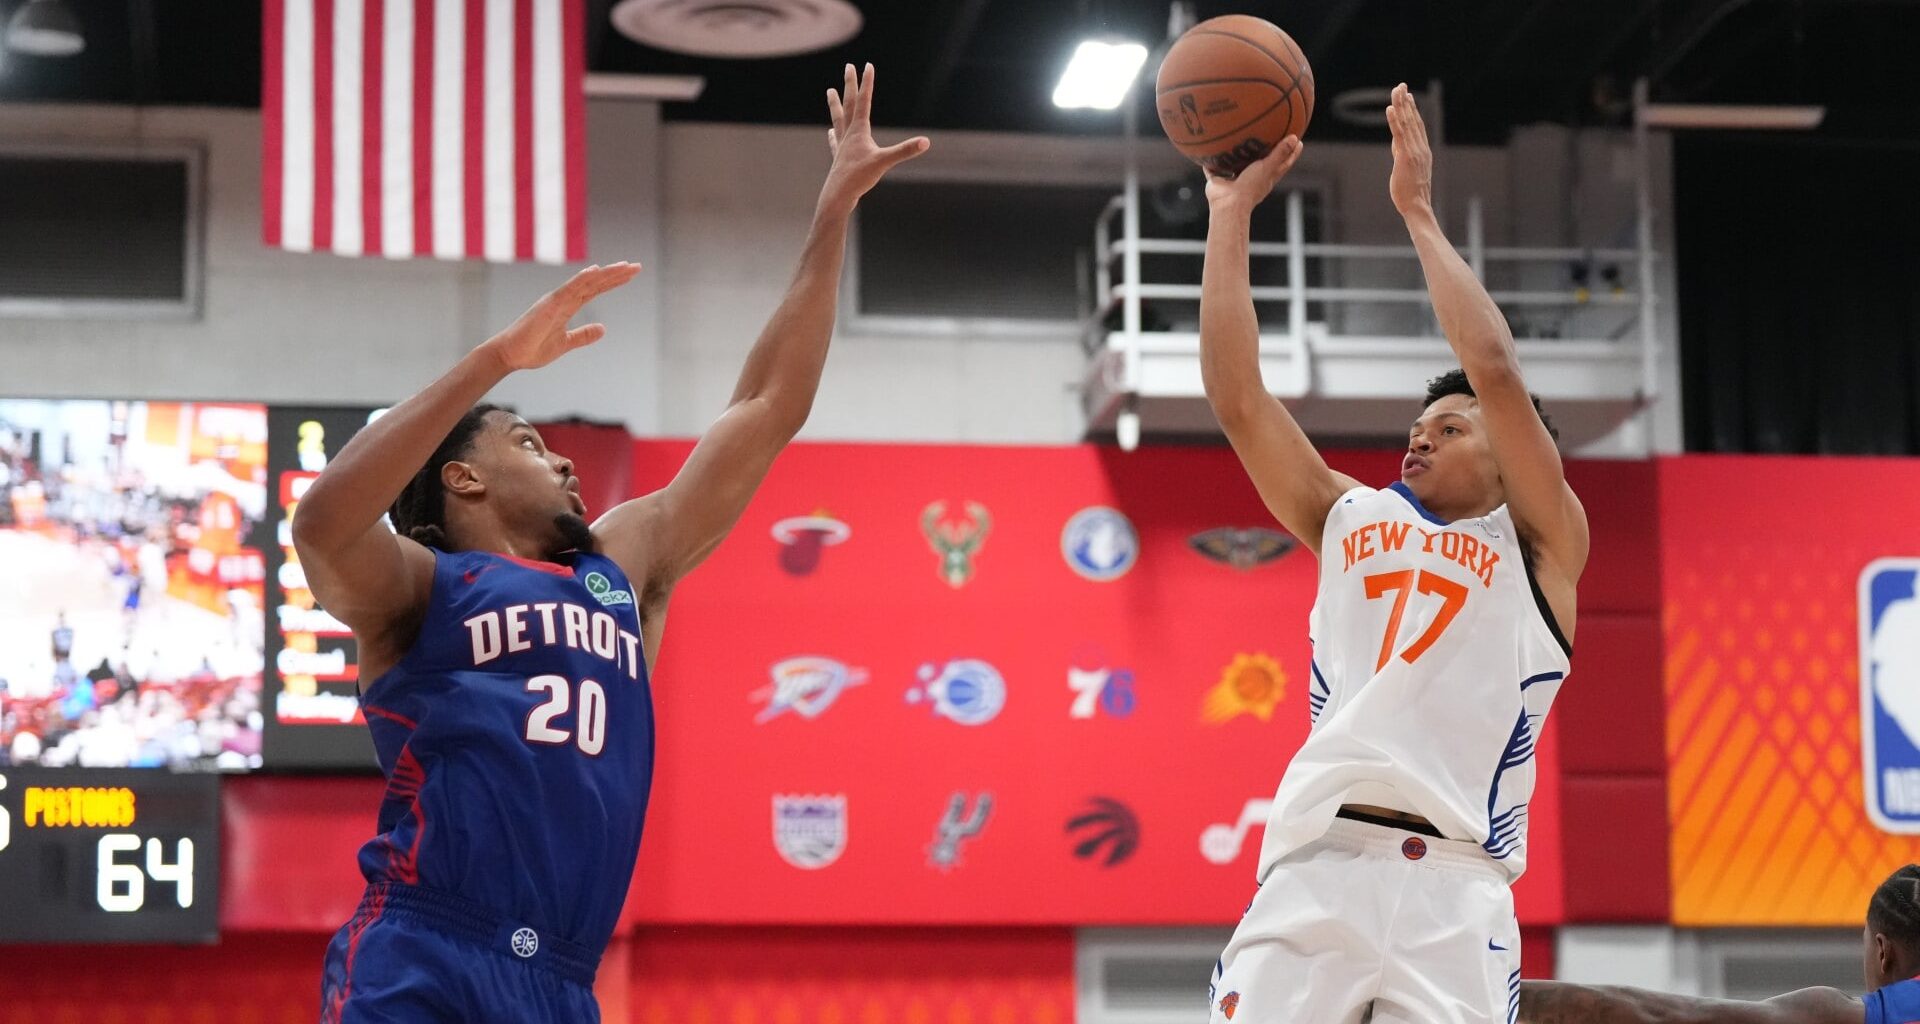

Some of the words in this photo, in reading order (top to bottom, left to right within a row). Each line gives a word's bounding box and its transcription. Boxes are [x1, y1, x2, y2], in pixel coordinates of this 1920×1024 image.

[1342, 521, 1413, 574] NEW
[1417, 527, 1500, 589] YORK
[463, 602, 639, 681] DETROT
[1363, 568, 1470, 676] 77
[525, 674, 606, 756] 20
[1067, 667, 1137, 720] 76
[97, 833, 194, 912] 64
